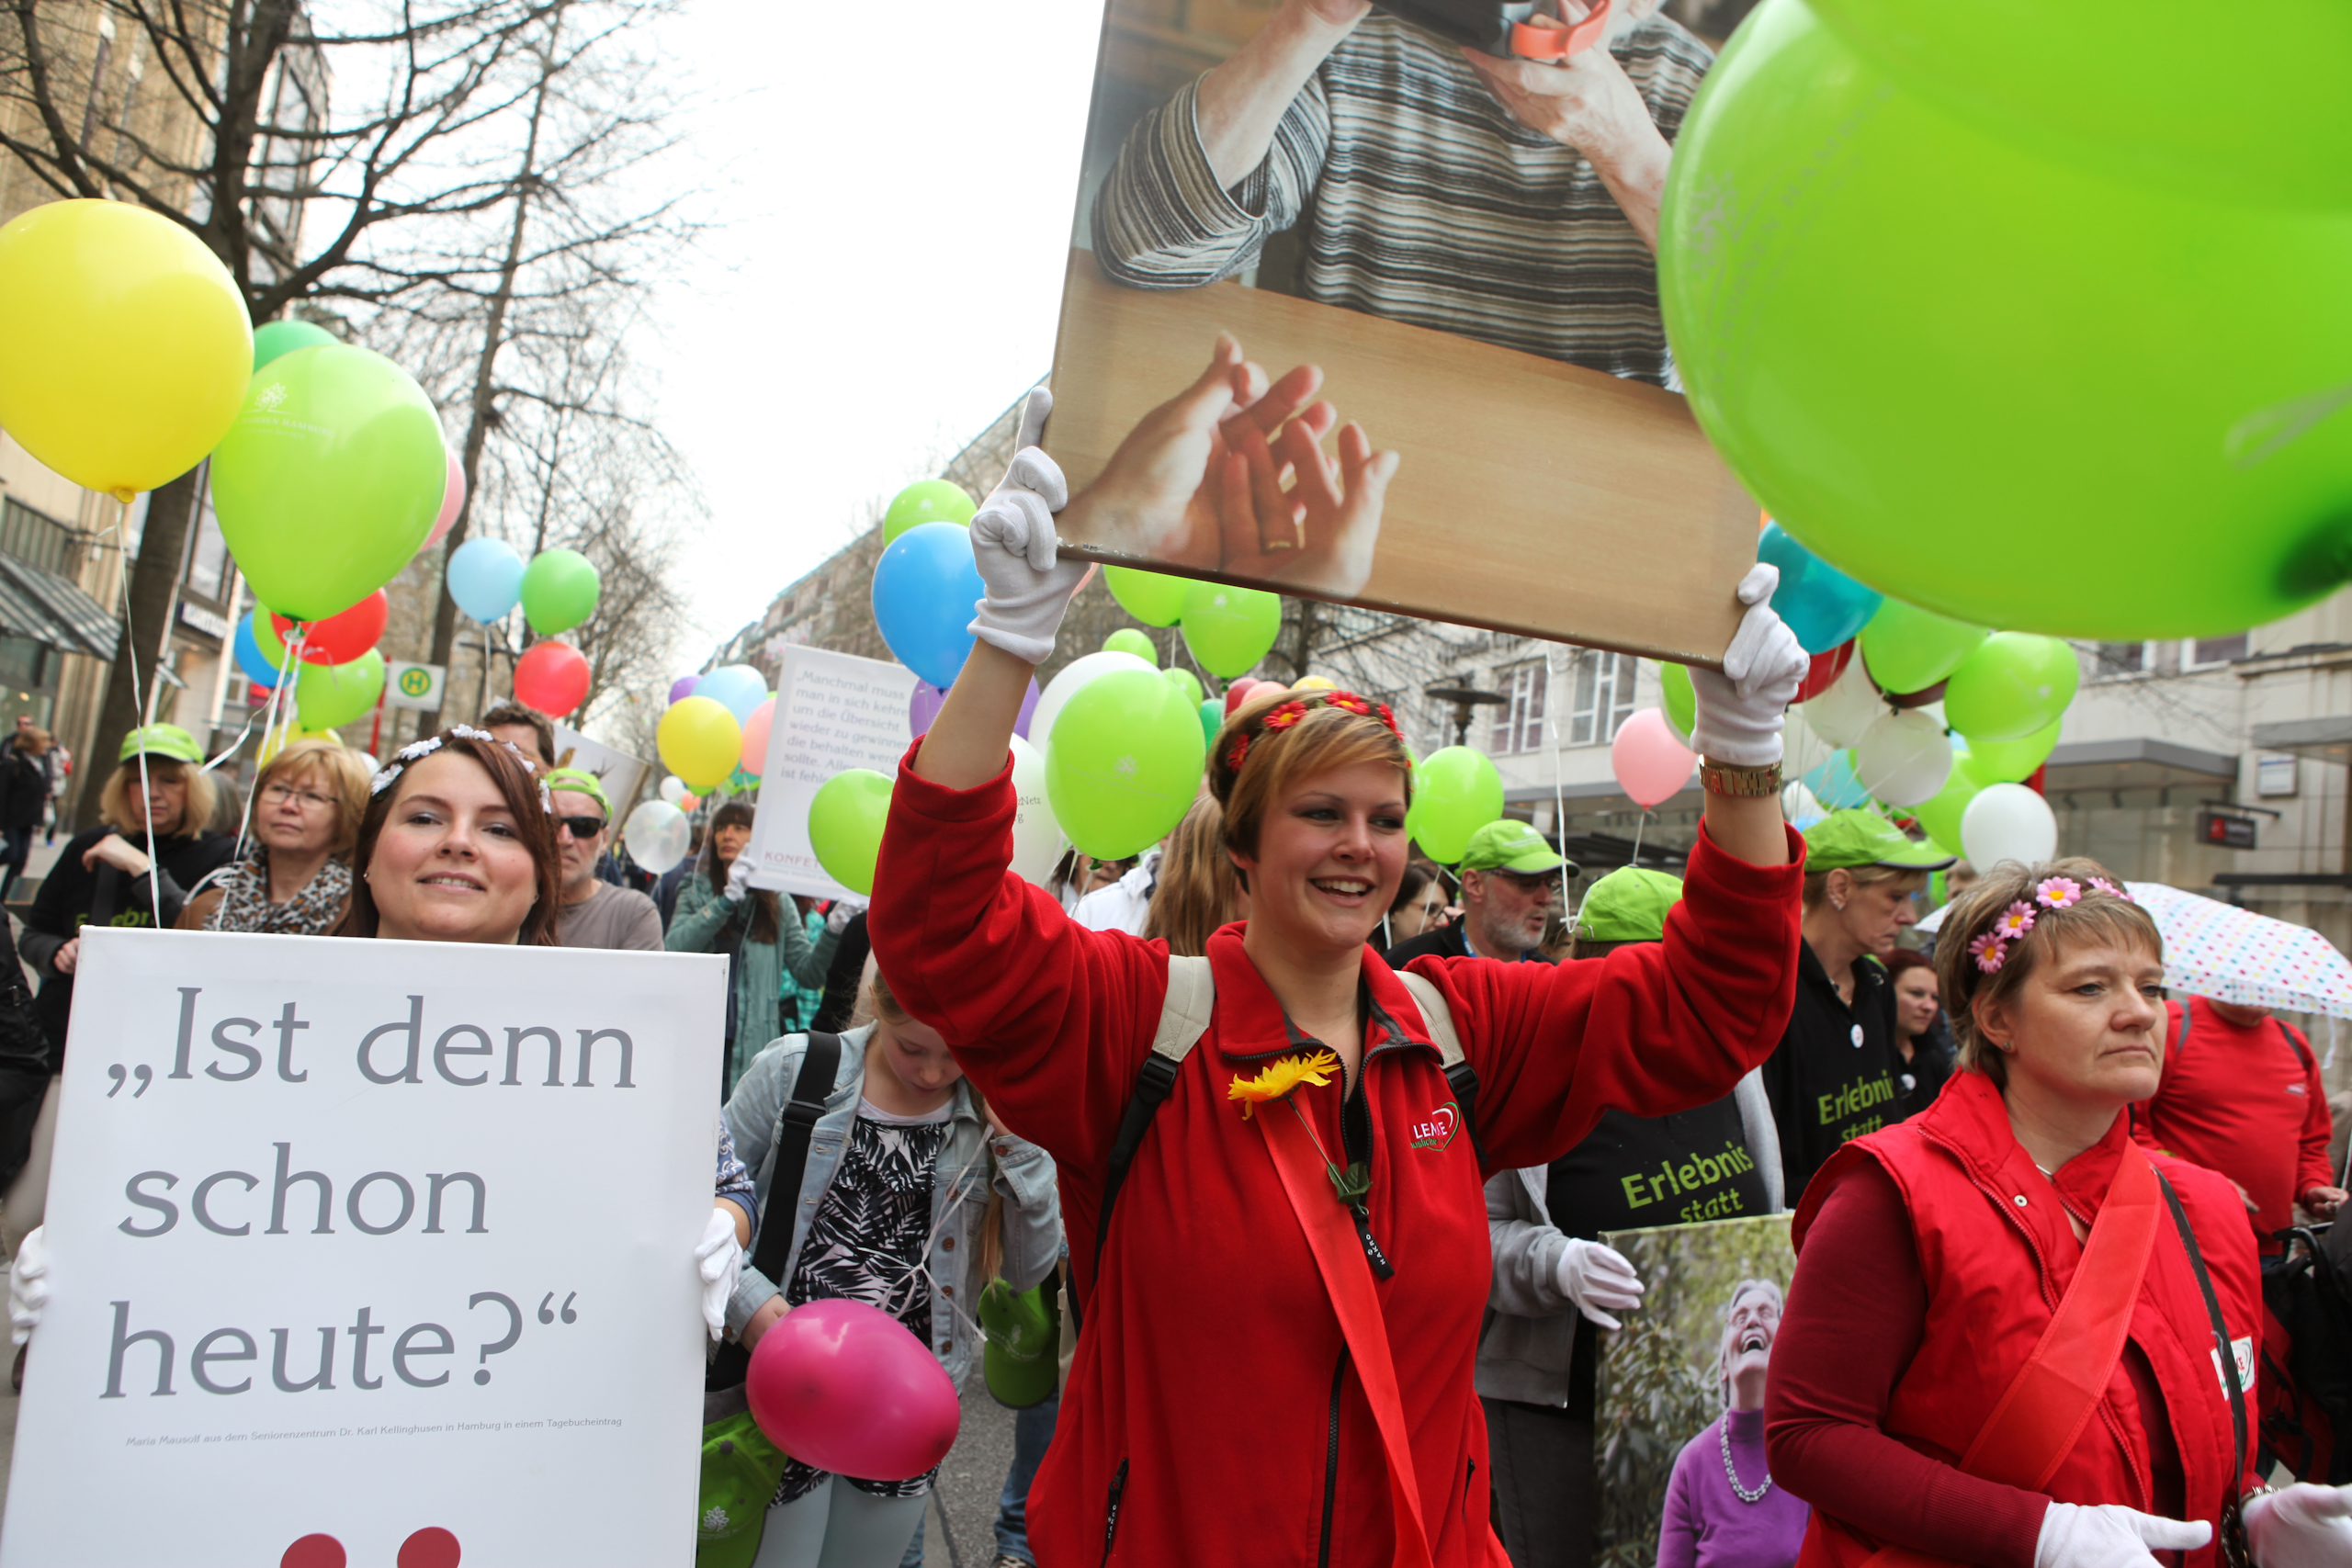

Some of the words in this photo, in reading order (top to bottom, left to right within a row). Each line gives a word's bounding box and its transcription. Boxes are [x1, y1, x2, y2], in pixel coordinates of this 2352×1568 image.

[407, 674, 424, 690] H
[872, 685, 905, 700] muss
[796, 688, 825, 702] man
[829, 690, 840, 704] in
[844, 694, 869, 711] sich
[874, 701, 910, 717] kehre
[789, 720, 831, 737] wieder
[834, 728, 849, 739] zu
[793, 704, 813, 716] um
[817, 706, 836, 720] die
[840, 708, 899, 733] Übersicht
[784, 750, 820, 768] sollte.
[787, 735, 807, 749] die
[810, 738, 864, 759] behalten
[868, 751, 900, 765] werd
[781, 766, 796, 780] ist
[764, 851, 820, 869] KONFET
[107, 987, 311, 1099] „Ist
[357, 995, 637, 1089] denn
[1817, 1069, 1894, 1125] Erlebni
[1621, 1140, 1755, 1209] Erlebnis
[118, 1143, 489, 1238] schon
[1679, 1188, 1744, 1224] statt
[1365, 1234, 1386, 1266] HAKRO
[98, 1292, 578, 1400] heute?“
[126, 1436, 156, 1447] Maria
[159, 1434, 201, 1446] Mausolf
[203, 1435, 221, 1443] aus
[225, 1433, 248, 1442] dem
[251, 1428, 336, 1440] Seniorenzentrum
[339, 1427, 354, 1437] Dr.
[357, 1427, 378, 1436] Karl
[380, 1424, 443, 1435] Kellinghusen
[446, 1423, 455, 1432] in
[458, 1421, 502, 1431] Hamburg
[504, 1420, 513, 1429] in
[515, 1420, 544, 1428] einem
[547, 1418, 623, 1429] Tagebucheintrag
